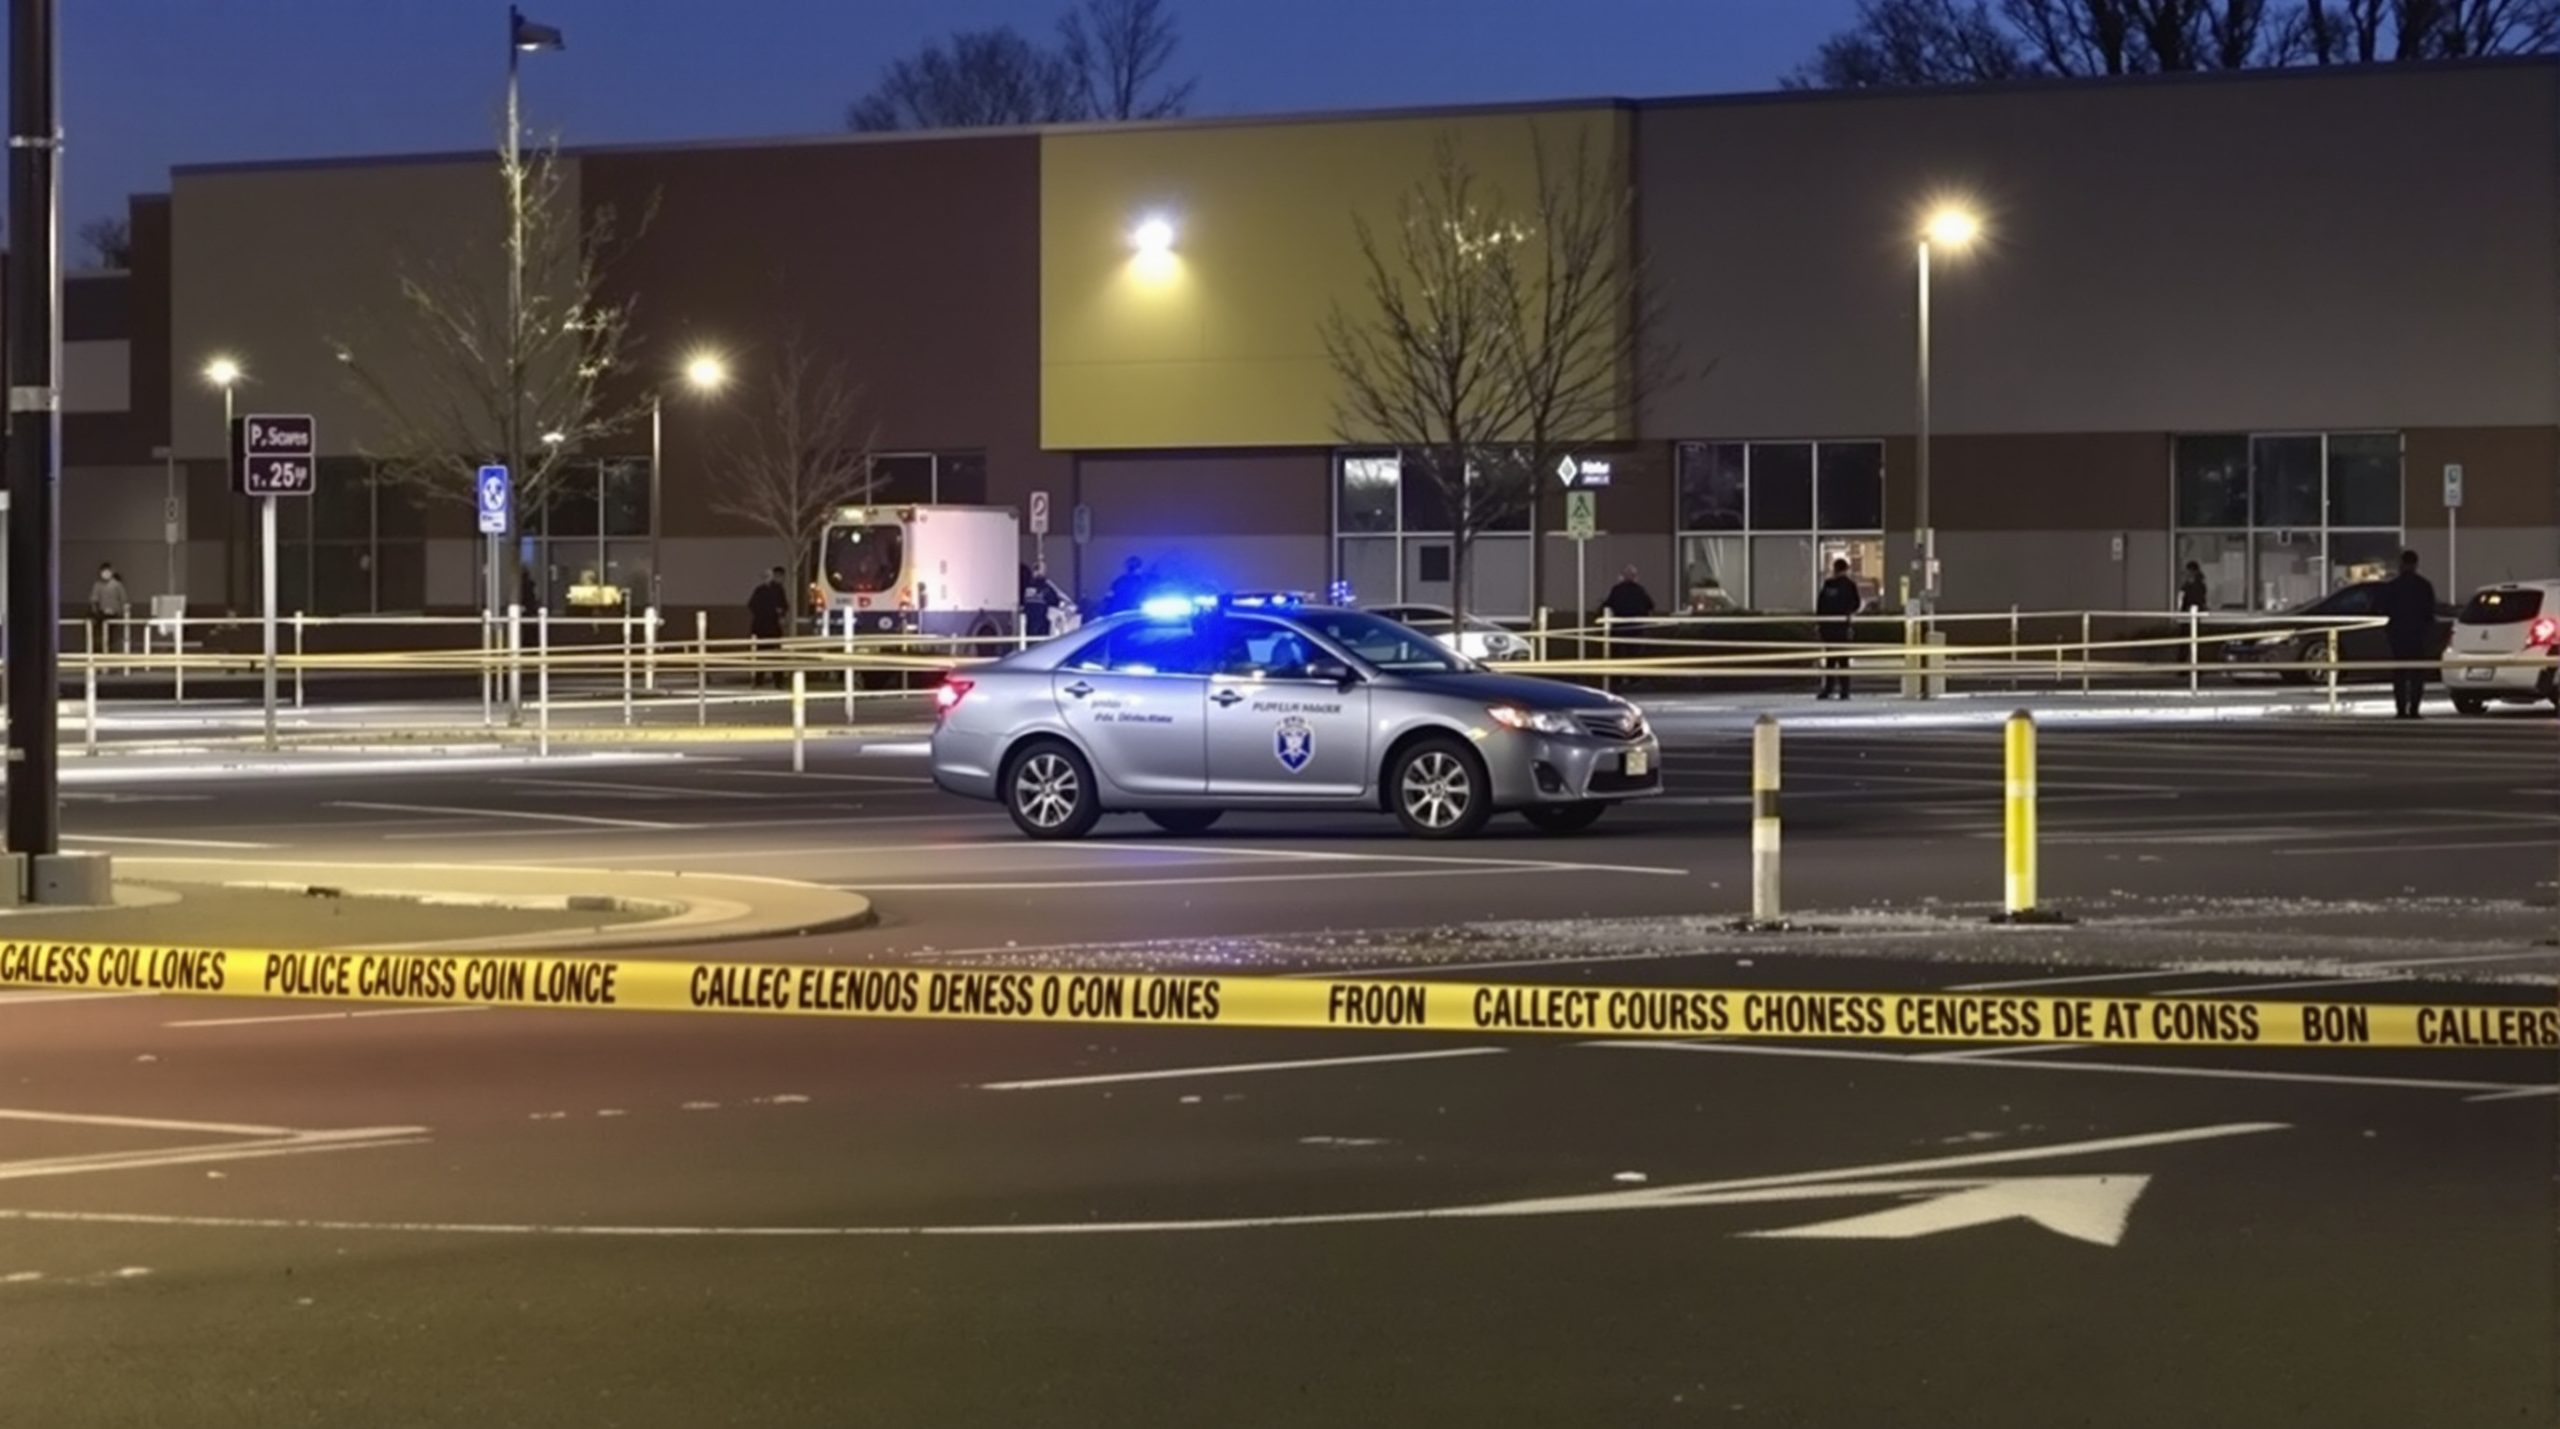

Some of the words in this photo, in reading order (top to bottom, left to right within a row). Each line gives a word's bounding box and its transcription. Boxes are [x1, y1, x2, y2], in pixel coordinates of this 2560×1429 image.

[1, 944, 91, 984] CALESS
[148, 949, 226, 990] LONES
[264, 954, 352, 995] POLICE
[358, 957, 456, 998] CAURSS
[464, 959, 524, 1000] COIN
[534, 961, 617, 1003] LONCE
[691, 966, 790, 1009] CALLEC
[798, 970, 919, 1012] ELENDOS
[928, 974, 1034, 1015] DENESS
[1068, 977, 1123, 1017] CON
[1132, 979, 1221, 1020] LONES
[1329, 985, 1426, 1025] FROON
[1474, 988, 1601, 1029] CALLECT
[1608, 991, 1729, 1032] COURSS
[1744, 994, 1884, 1033] CHONESS
[1896, 997, 2041, 1037] CENCESS
[2054, 1001, 2093, 1038] DE
[2104, 1002, 2142, 1039] AT
[2152, 1004, 2260, 1041] CONSS
[2303, 1006, 2370, 1043] BON
